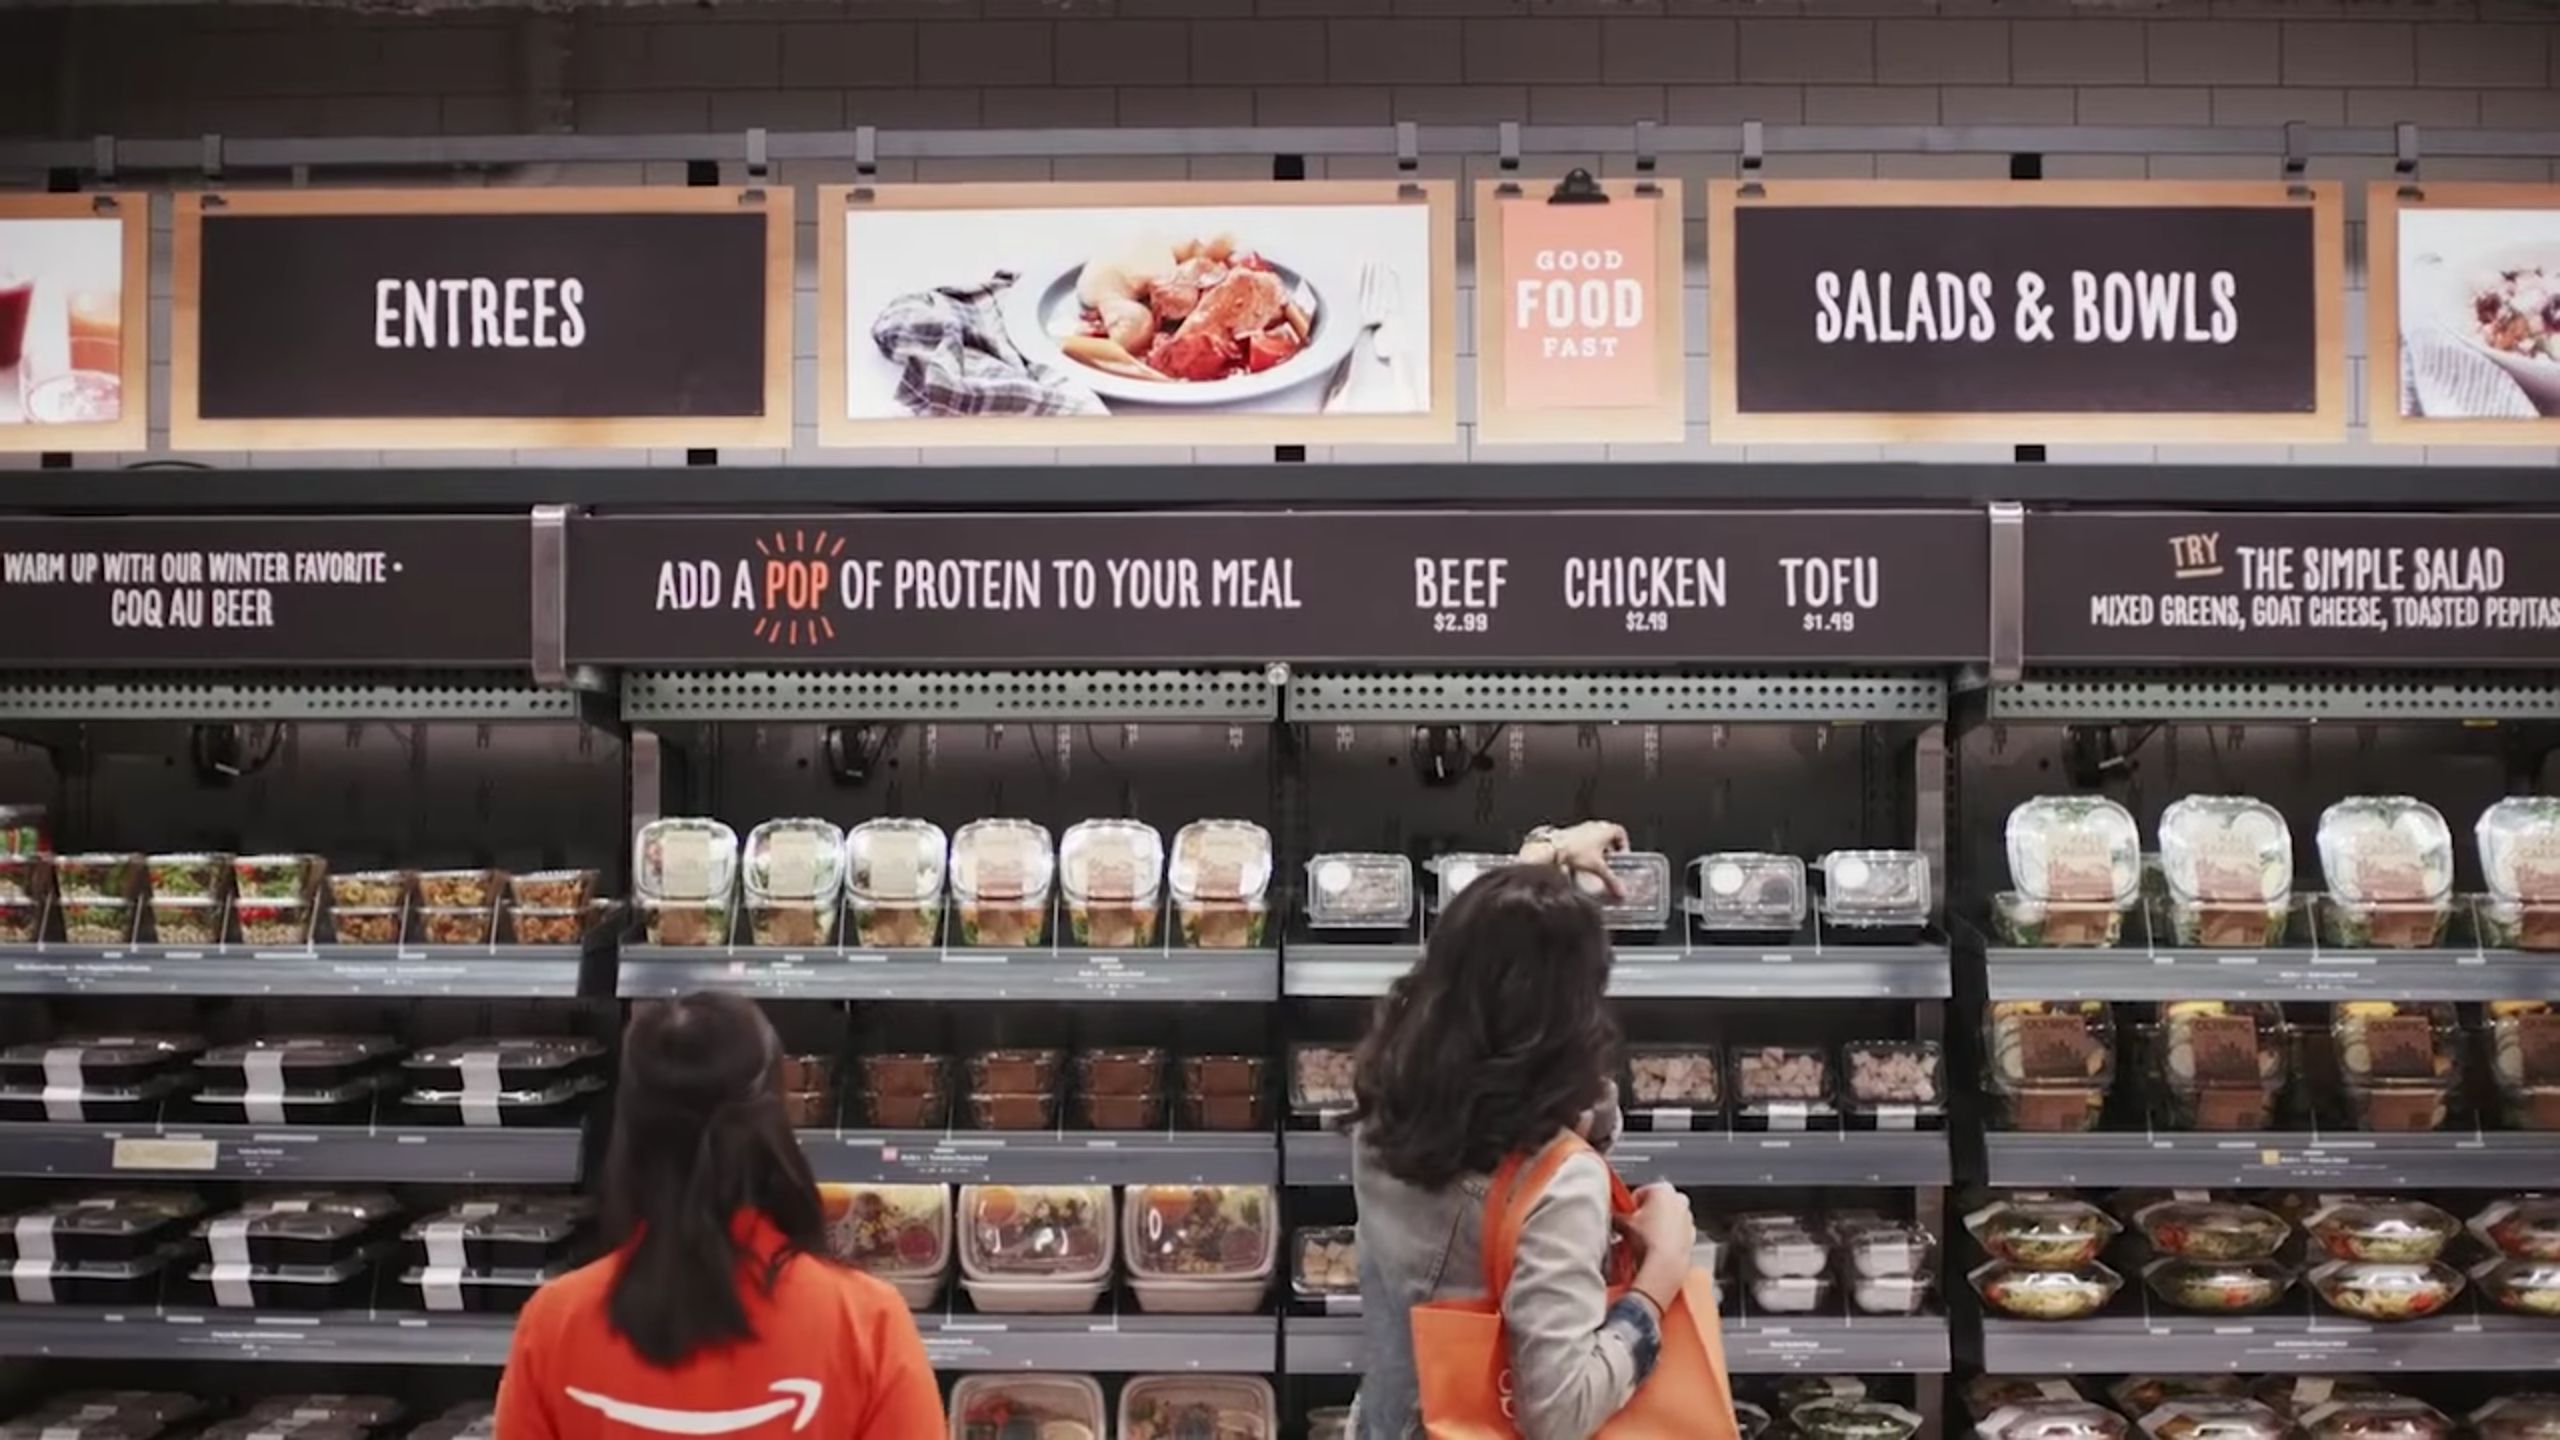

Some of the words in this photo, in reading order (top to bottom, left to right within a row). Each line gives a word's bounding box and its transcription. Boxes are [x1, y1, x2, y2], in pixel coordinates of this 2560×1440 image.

[1536, 250, 1623, 270] GOOD
[375, 277, 586, 348] ENTREES
[1516, 278, 1644, 329] FOOD
[1815, 269, 1996, 342] SALADS
[2014, 270, 2054, 342] &
[2072, 269, 2238, 343] BOWLS
[1542, 337, 1619, 357] FAST
[3, 552, 65, 583] WARM
[71, 552, 98, 583] UP
[103, 552, 156, 583] WITH
[161, 552, 203, 583] OUR
[208, 551, 291, 583] WINTER
[294, 551, 387, 583] FAVORITE
[2169, 532, 2220, 567] TRY
[655, 560, 721, 610] ADD
[731, 560, 756, 610] A
[766, 561, 830, 609] POP
[840, 559, 884, 609] OF
[894, 559, 1041, 610] PROTEIN
[1051, 559, 1096, 609] TO
[1106, 558, 1202, 609] YOUR
[1211, 557, 1302, 609] MEAL
[1414, 557, 1509, 609] BEEF
[1564, 556, 1727, 608] CHICKEN
[1778, 556, 1879, 609] TOFU
[2235, 546, 2294, 590] THE
[2303, 546, 2405, 592] SIMPLE
[2413, 546, 2505, 593] SALAD
[111, 588, 164, 627] COQ
[168, 588, 203, 627] AU
[212, 588, 274, 627] BEER
[1433, 612, 1489, 633] $2.99
[1625, 611, 1668, 632] $2.49
[1803, 612, 1855, 632] $1.49
[2090, 595, 2154, 627] MIXED
[2160, 595, 2246, 632] GREENS,
[2252, 595, 2303, 627] GOAT
[2308, 596, 2388, 632] CHEESE,
[2392, 596, 2480, 628] TOASTED
